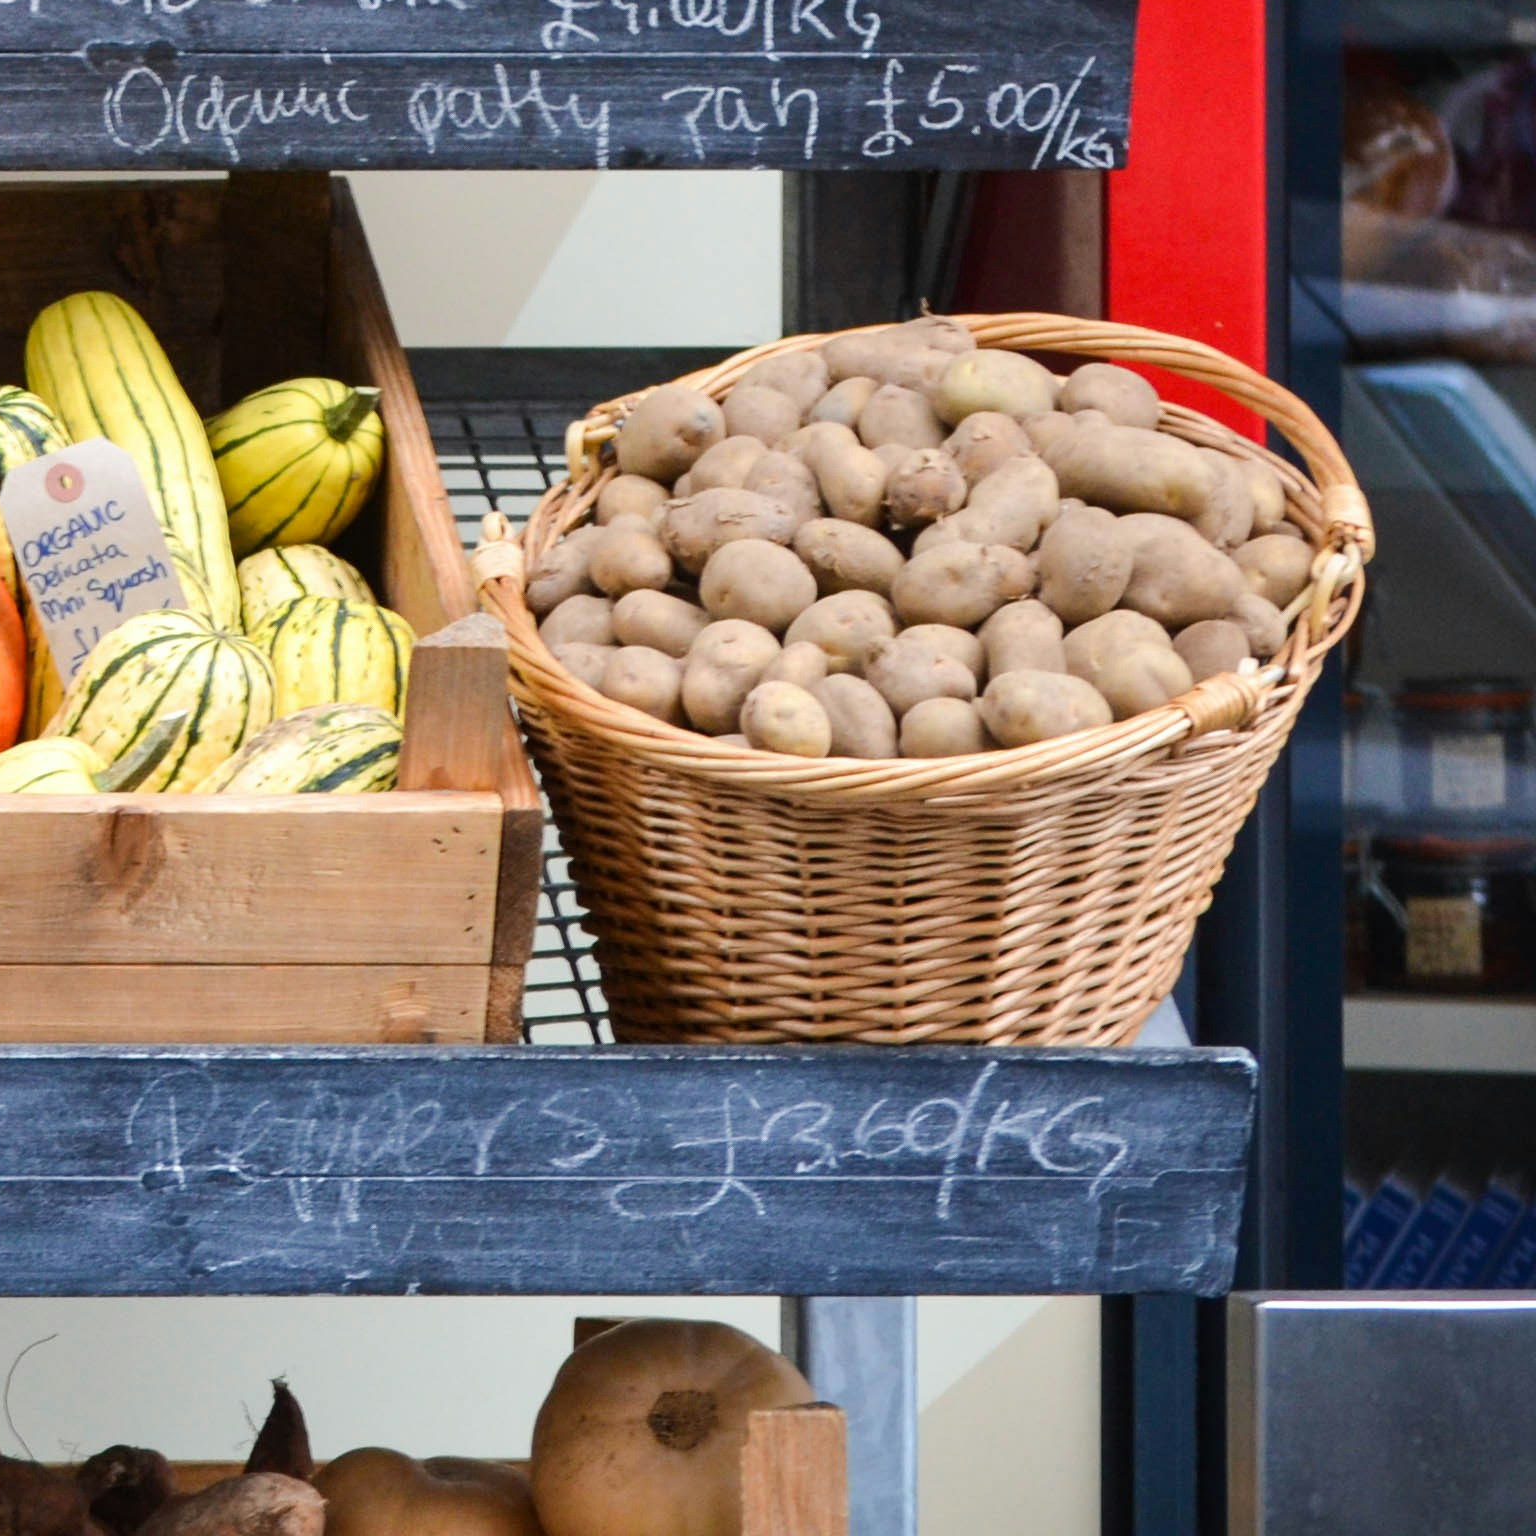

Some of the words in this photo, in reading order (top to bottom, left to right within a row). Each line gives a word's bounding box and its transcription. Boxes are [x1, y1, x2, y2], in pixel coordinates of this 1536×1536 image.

[21, 499, 126, 568] ORGANIC
[27, 542, 129, 596] Delicata
[39, 586, 86, 623] Mini
[86, 554, 168, 613] Squash
